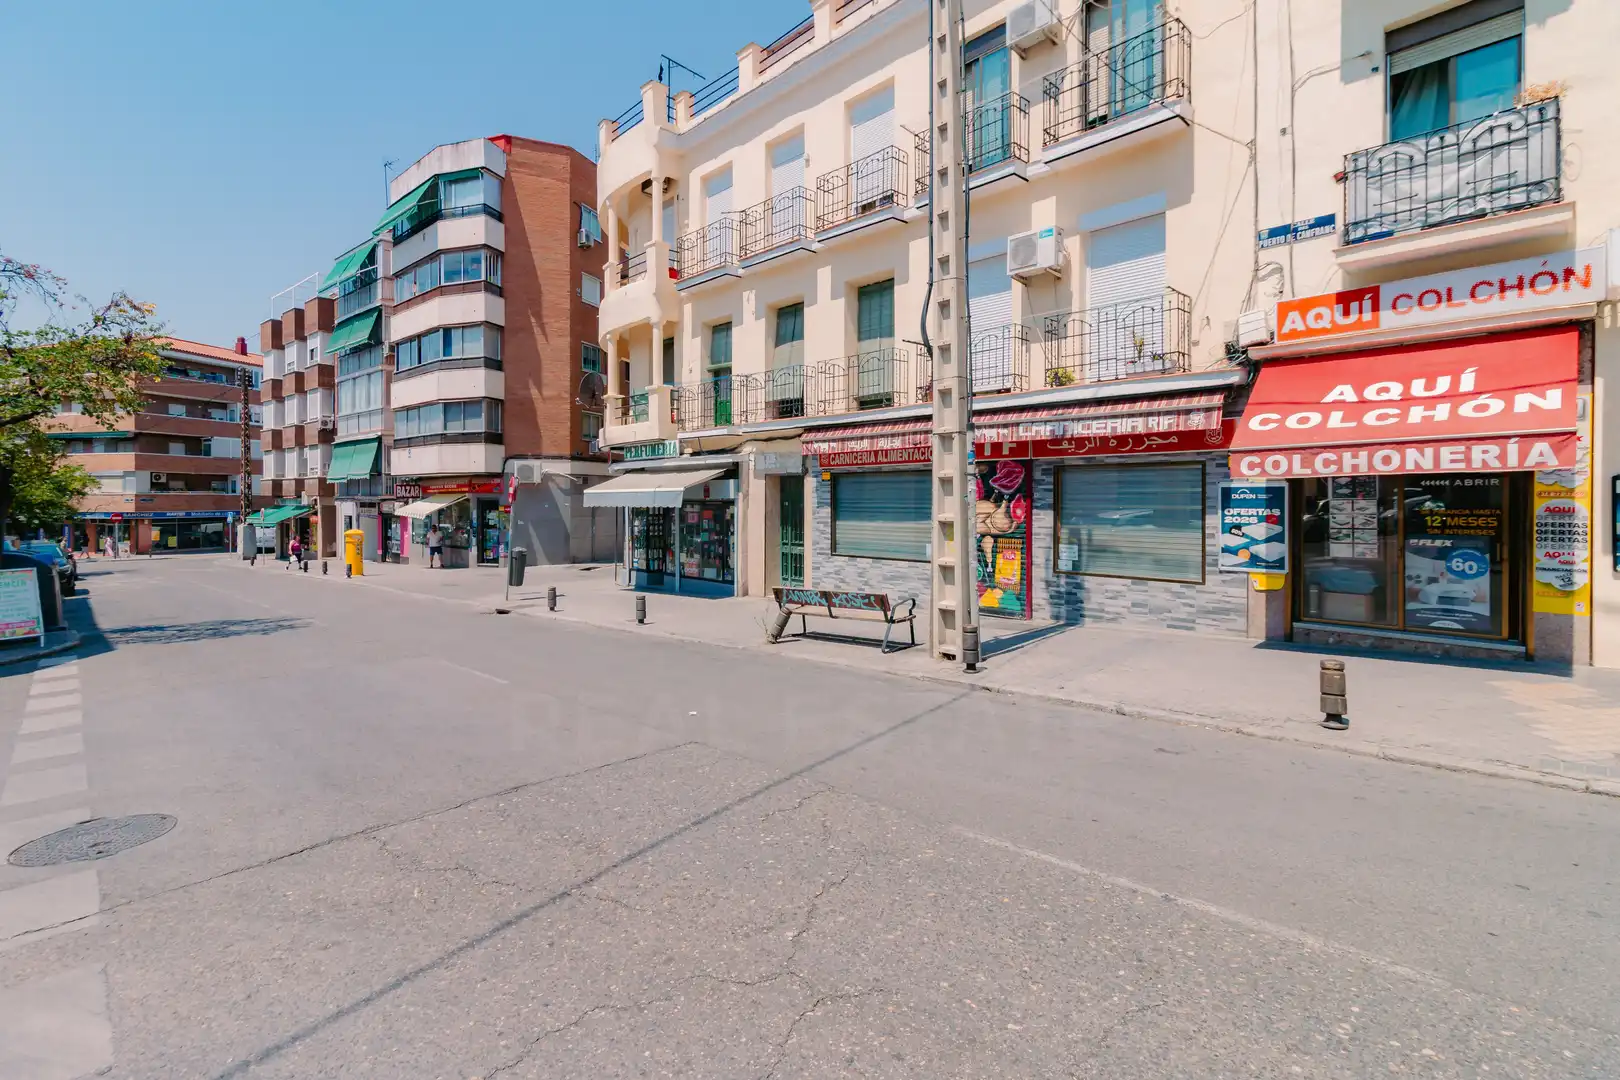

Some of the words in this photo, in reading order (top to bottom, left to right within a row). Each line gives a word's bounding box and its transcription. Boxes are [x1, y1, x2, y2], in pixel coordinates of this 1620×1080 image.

[1259, 235, 1285, 248] PUERTO
[1297, 224, 1335, 240] CANFRANC
[1281, 294, 1373, 334] AQUÍ
[1391, 260, 1592, 316] COLCHÓN
[1320, 366, 1479, 403] AQUÍ
[1248, 388, 1563, 431] COLCHÓN
[1148, 415, 1175, 430] RIF
[830, 452, 876, 465] CARNICERIA
[1240, 439, 1559, 476] COLCHONERÍA
[1453, 478, 1500, 486] ABRIR
[396, 486, 420, 497] BAZAR
[1224, 508, 1281, 516] OFERTAS
[1425, 516, 1442, 527] 12
[1447, 517, 1498, 527] MESES
[1419, 539, 1453, 547] FLEX
